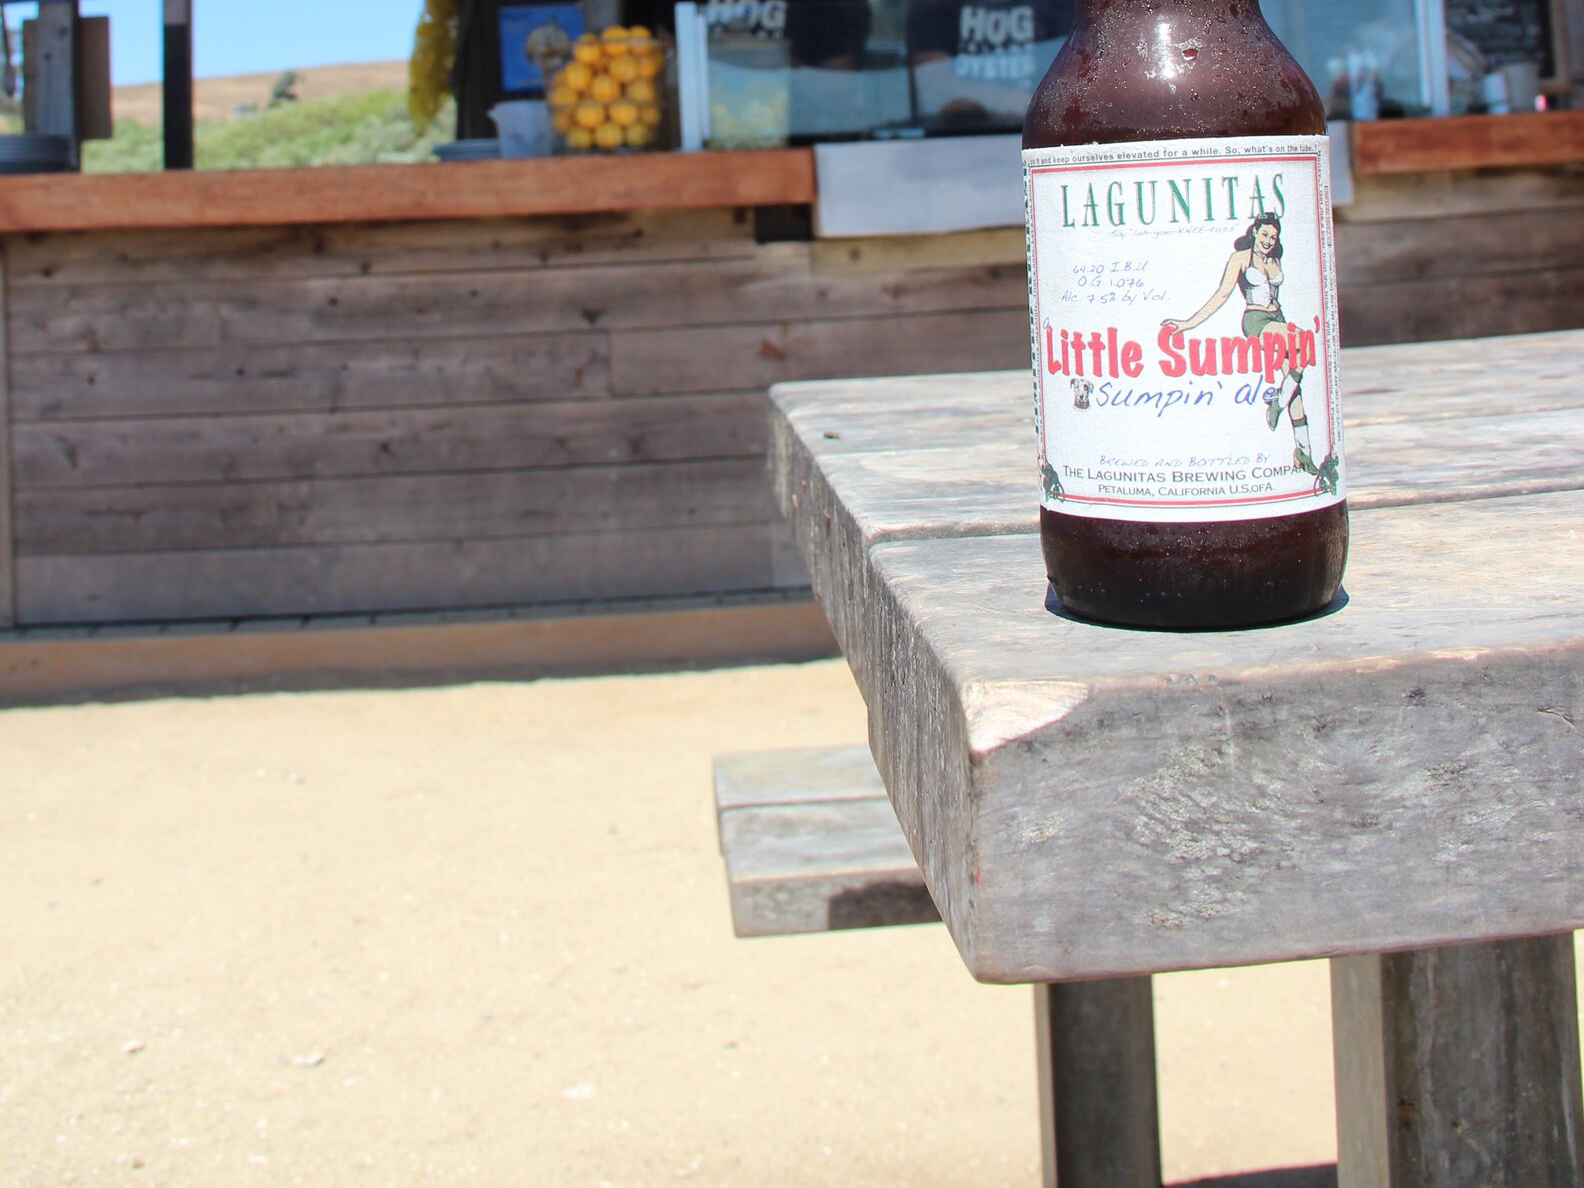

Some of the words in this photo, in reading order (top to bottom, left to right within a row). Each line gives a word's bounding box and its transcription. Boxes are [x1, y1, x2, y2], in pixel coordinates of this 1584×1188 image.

[960, 5, 1035, 44] HOG
[1041, 157, 1051, 165] and
[1053, 156, 1069, 165] keep
[1072, 153, 1114, 163] ourselves
[1117, 149, 1160, 160] elevated
[1163, 149, 1178, 158] for
[1191, 147, 1222, 156] while.
[1225, 146, 1241, 155] So,
[1244, 145, 1273, 153] what's
[1287, 144, 1298, 152] the
[1061, 173, 1286, 228] LAGUNITAS
[1077, 275, 1105, 287] O.G.
[1110, 278, 1145, 288] 1.076
[1087, 291, 1116, 304] 7.5%
[1121, 290, 1137, 306] by
[1142, 288, 1171, 301] Vol.
[1045, 324, 1144, 379] Little
[1156, 315, 1320, 385] Sumpin'
[1096, 380, 1224, 418] Sumpin'
[1234, 374, 1278, 406] ale
[1100, 455, 1148, 467] BREWED
[1154, 457, 1183, 468] AND
[1188, 455, 1251, 467] BOTTLED
[1256, 453, 1272, 464] BY
[1087, 469, 1167, 483] LAGUNITAS
[1171, 469, 1246, 483] BREWING
[1098, 484, 1156, 497] PETALUMA,
[1158, 486, 1226, 497] CALIFORNIA
